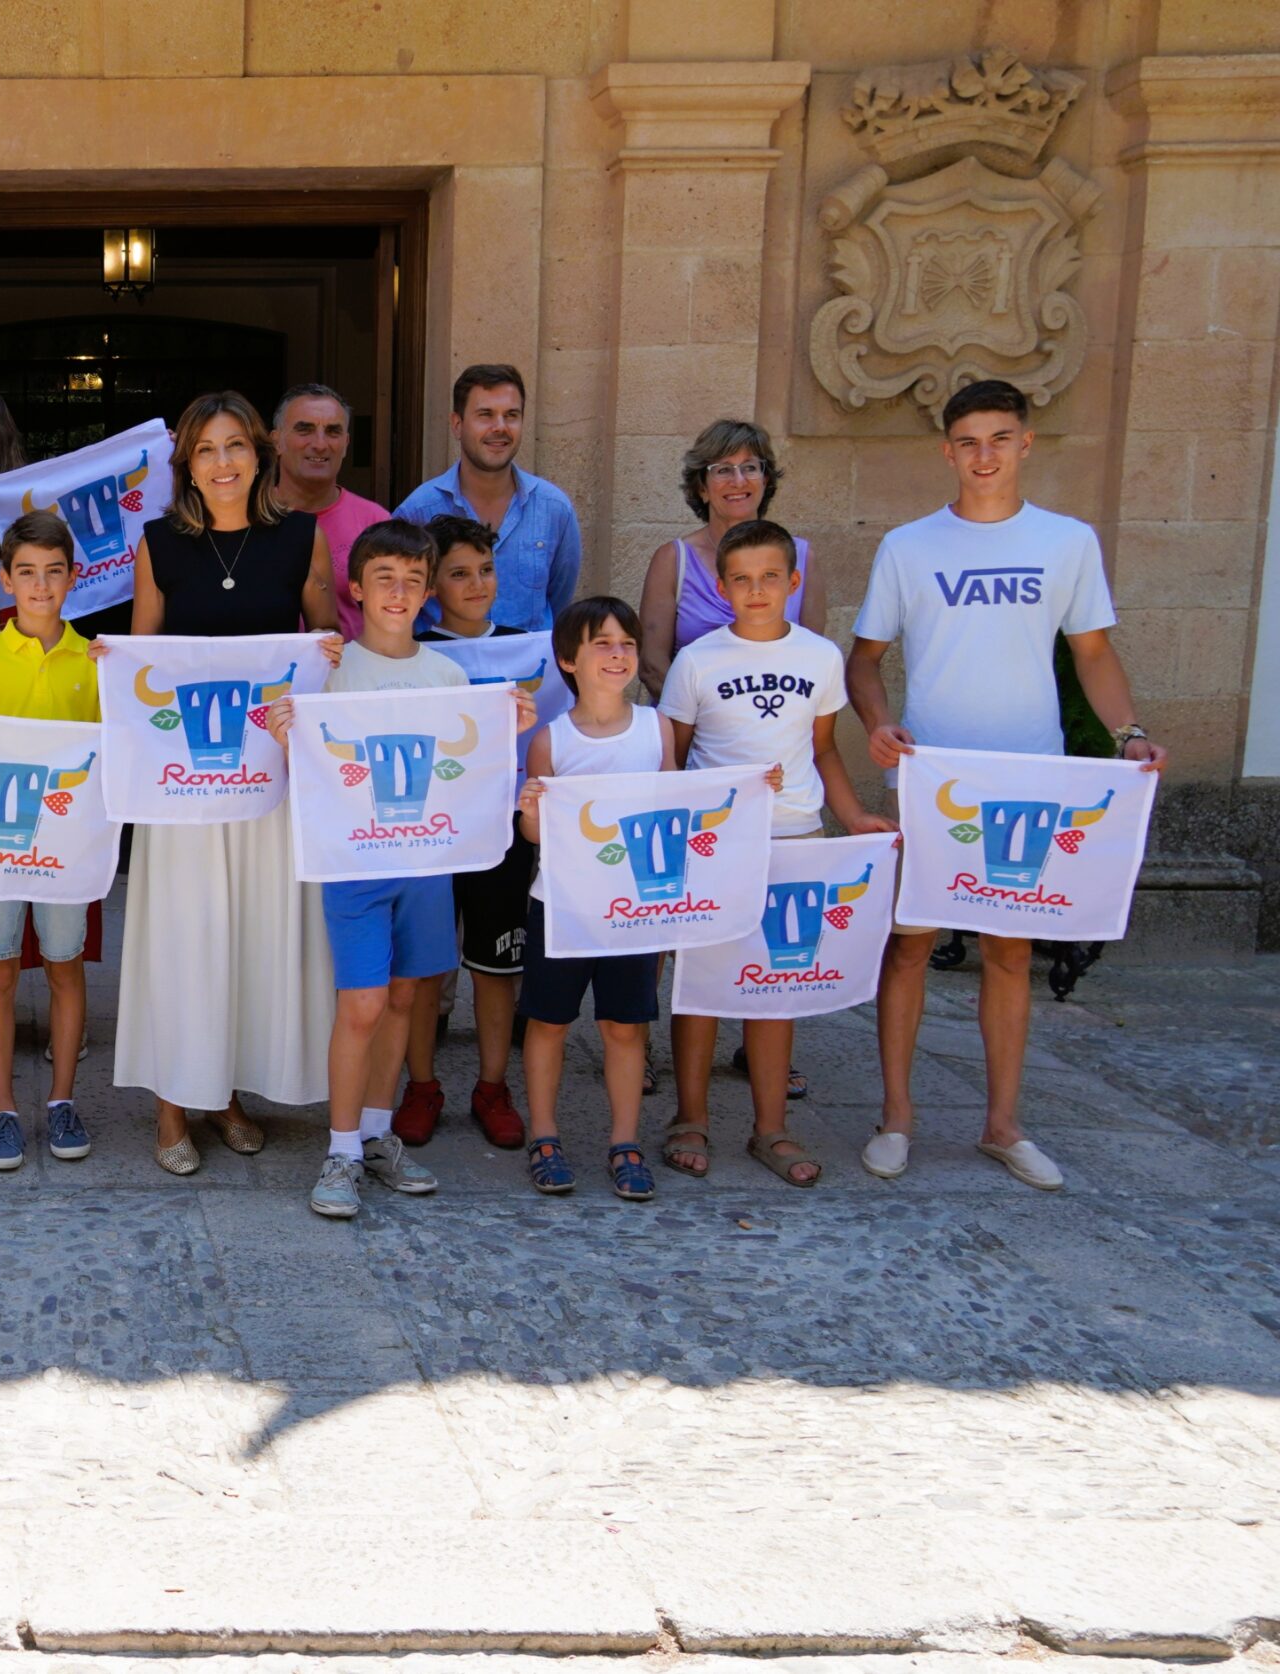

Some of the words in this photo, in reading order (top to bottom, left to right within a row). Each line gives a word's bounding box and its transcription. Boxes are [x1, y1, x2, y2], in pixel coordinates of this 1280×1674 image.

[72, 544, 136, 579] Rond
[934, 567, 1044, 607] VANS
[717, 673, 815, 700] SILBON
[157, 763, 273, 785] Ronda
[164, 786, 209, 796] SUERTE
[215, 786, 265, 796] NATURAL
[3, 867, 56, 879] NATURAL
[946, 872, 1073, 906] Ronda
[603, 891, 721, 919] Ronda
[952, 892, 999, 908] SUERTE
[1005, 903, 1064, 916] NATURAL
[610, 918, 655, 929] SUERTE
[661, 914, 714, 925] NATURAL
[495, 930, 511, 957] NEW
[733, 961, 845, 986] Ronda
[740, 986, 783, 995] SUERTE
[789, 982, 837, 993] NATURAL
